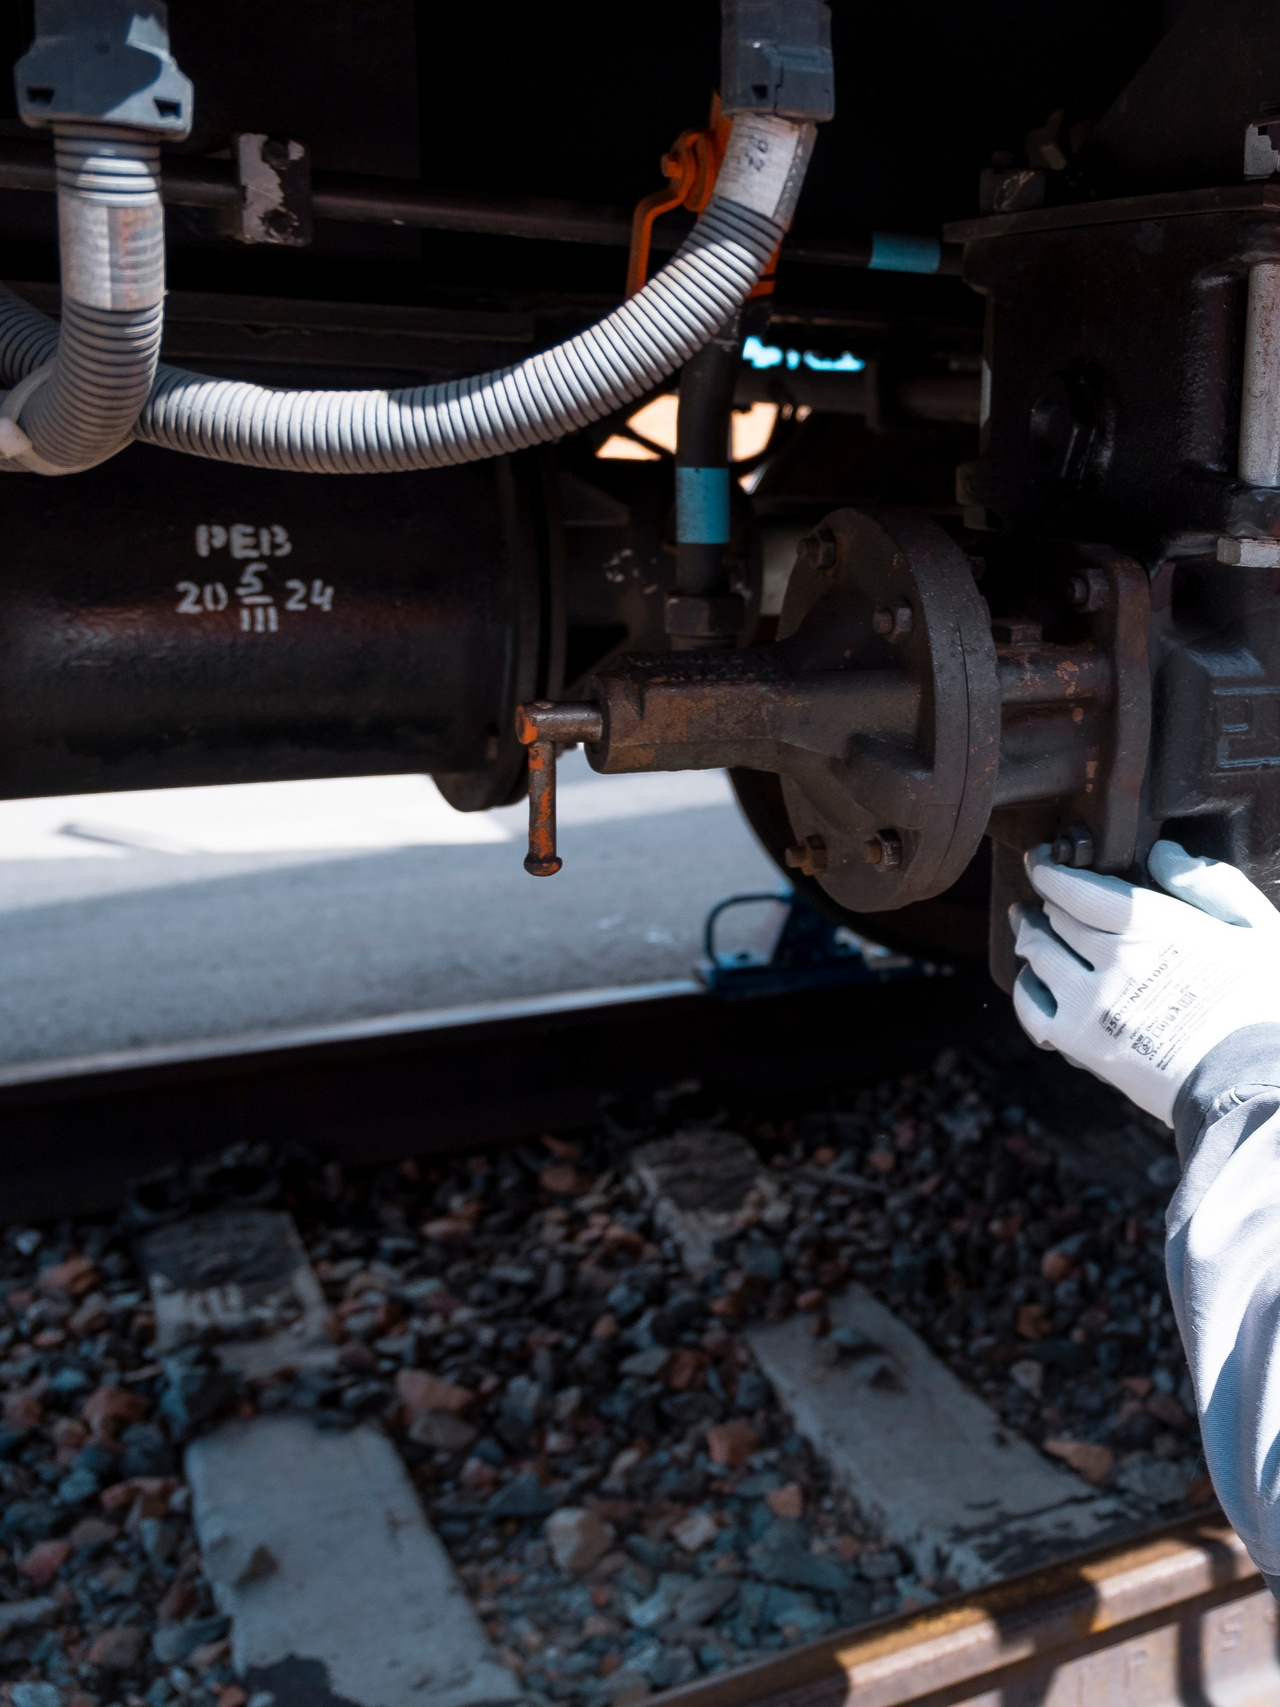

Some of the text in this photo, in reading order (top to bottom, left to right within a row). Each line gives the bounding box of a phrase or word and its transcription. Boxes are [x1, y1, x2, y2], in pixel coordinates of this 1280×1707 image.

[175, 561, 336, 614] 20 5 24
